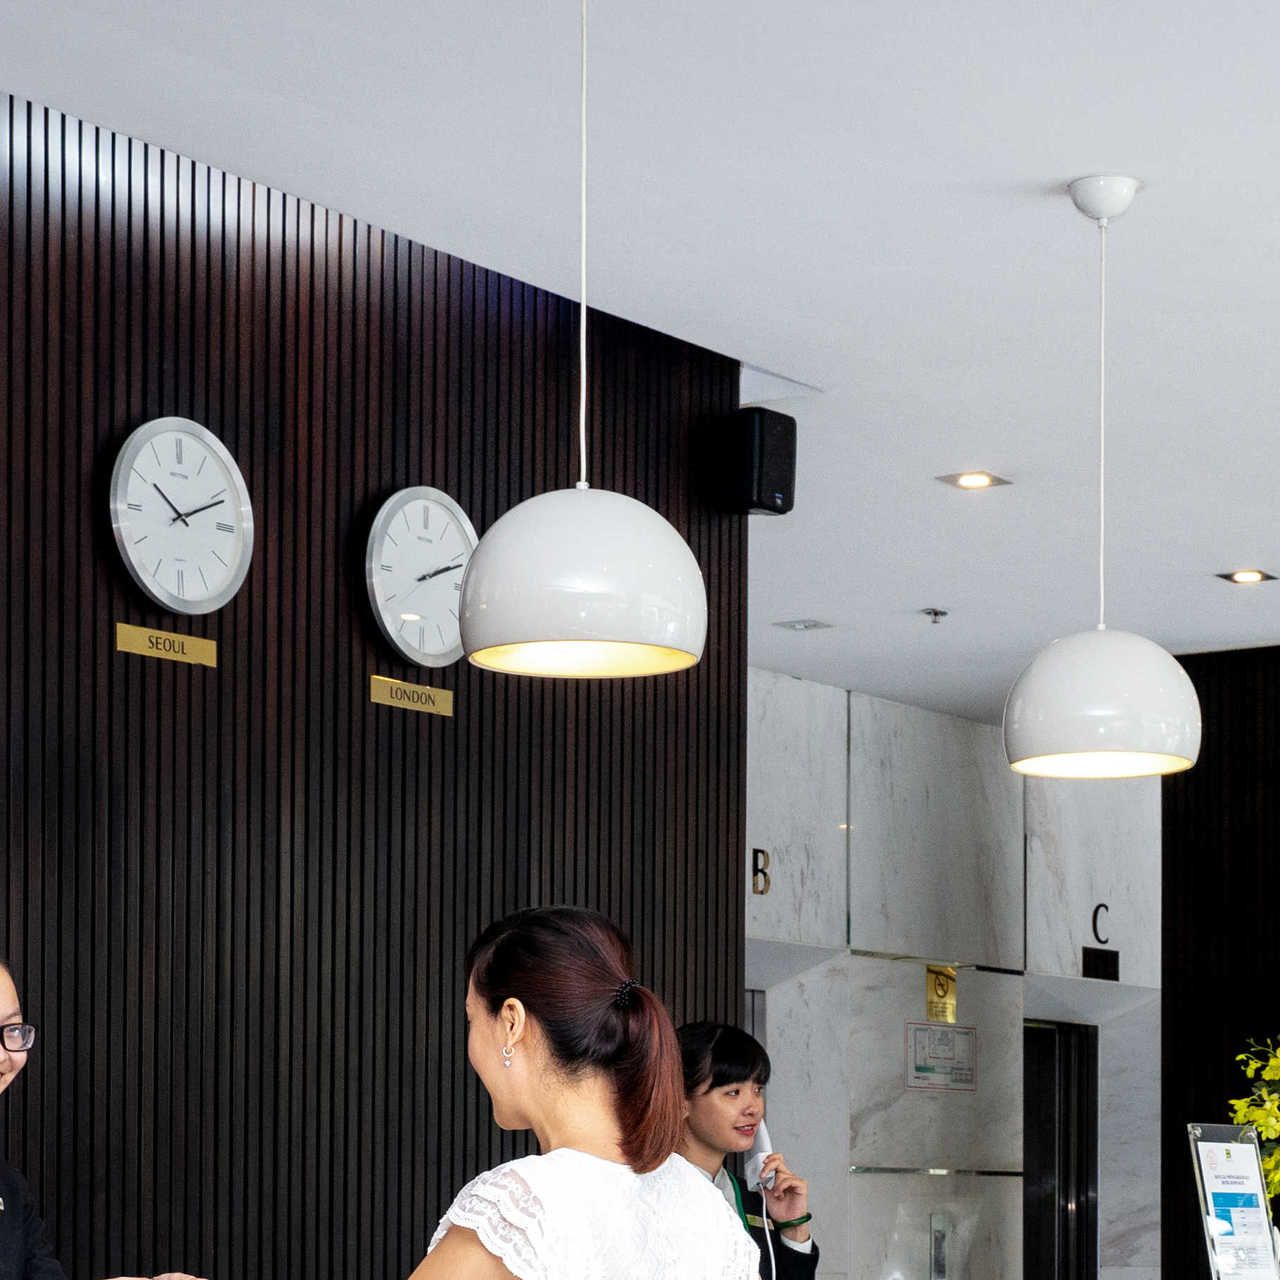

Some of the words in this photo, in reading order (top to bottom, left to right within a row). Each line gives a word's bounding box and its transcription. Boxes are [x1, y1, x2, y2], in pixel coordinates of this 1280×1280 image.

[147, 634, 188, 656] SEOUL
[389, 686, 436, 707] LONDON
[752, 848, 771, 895] B
[1092, 903, 1109, 945] C
